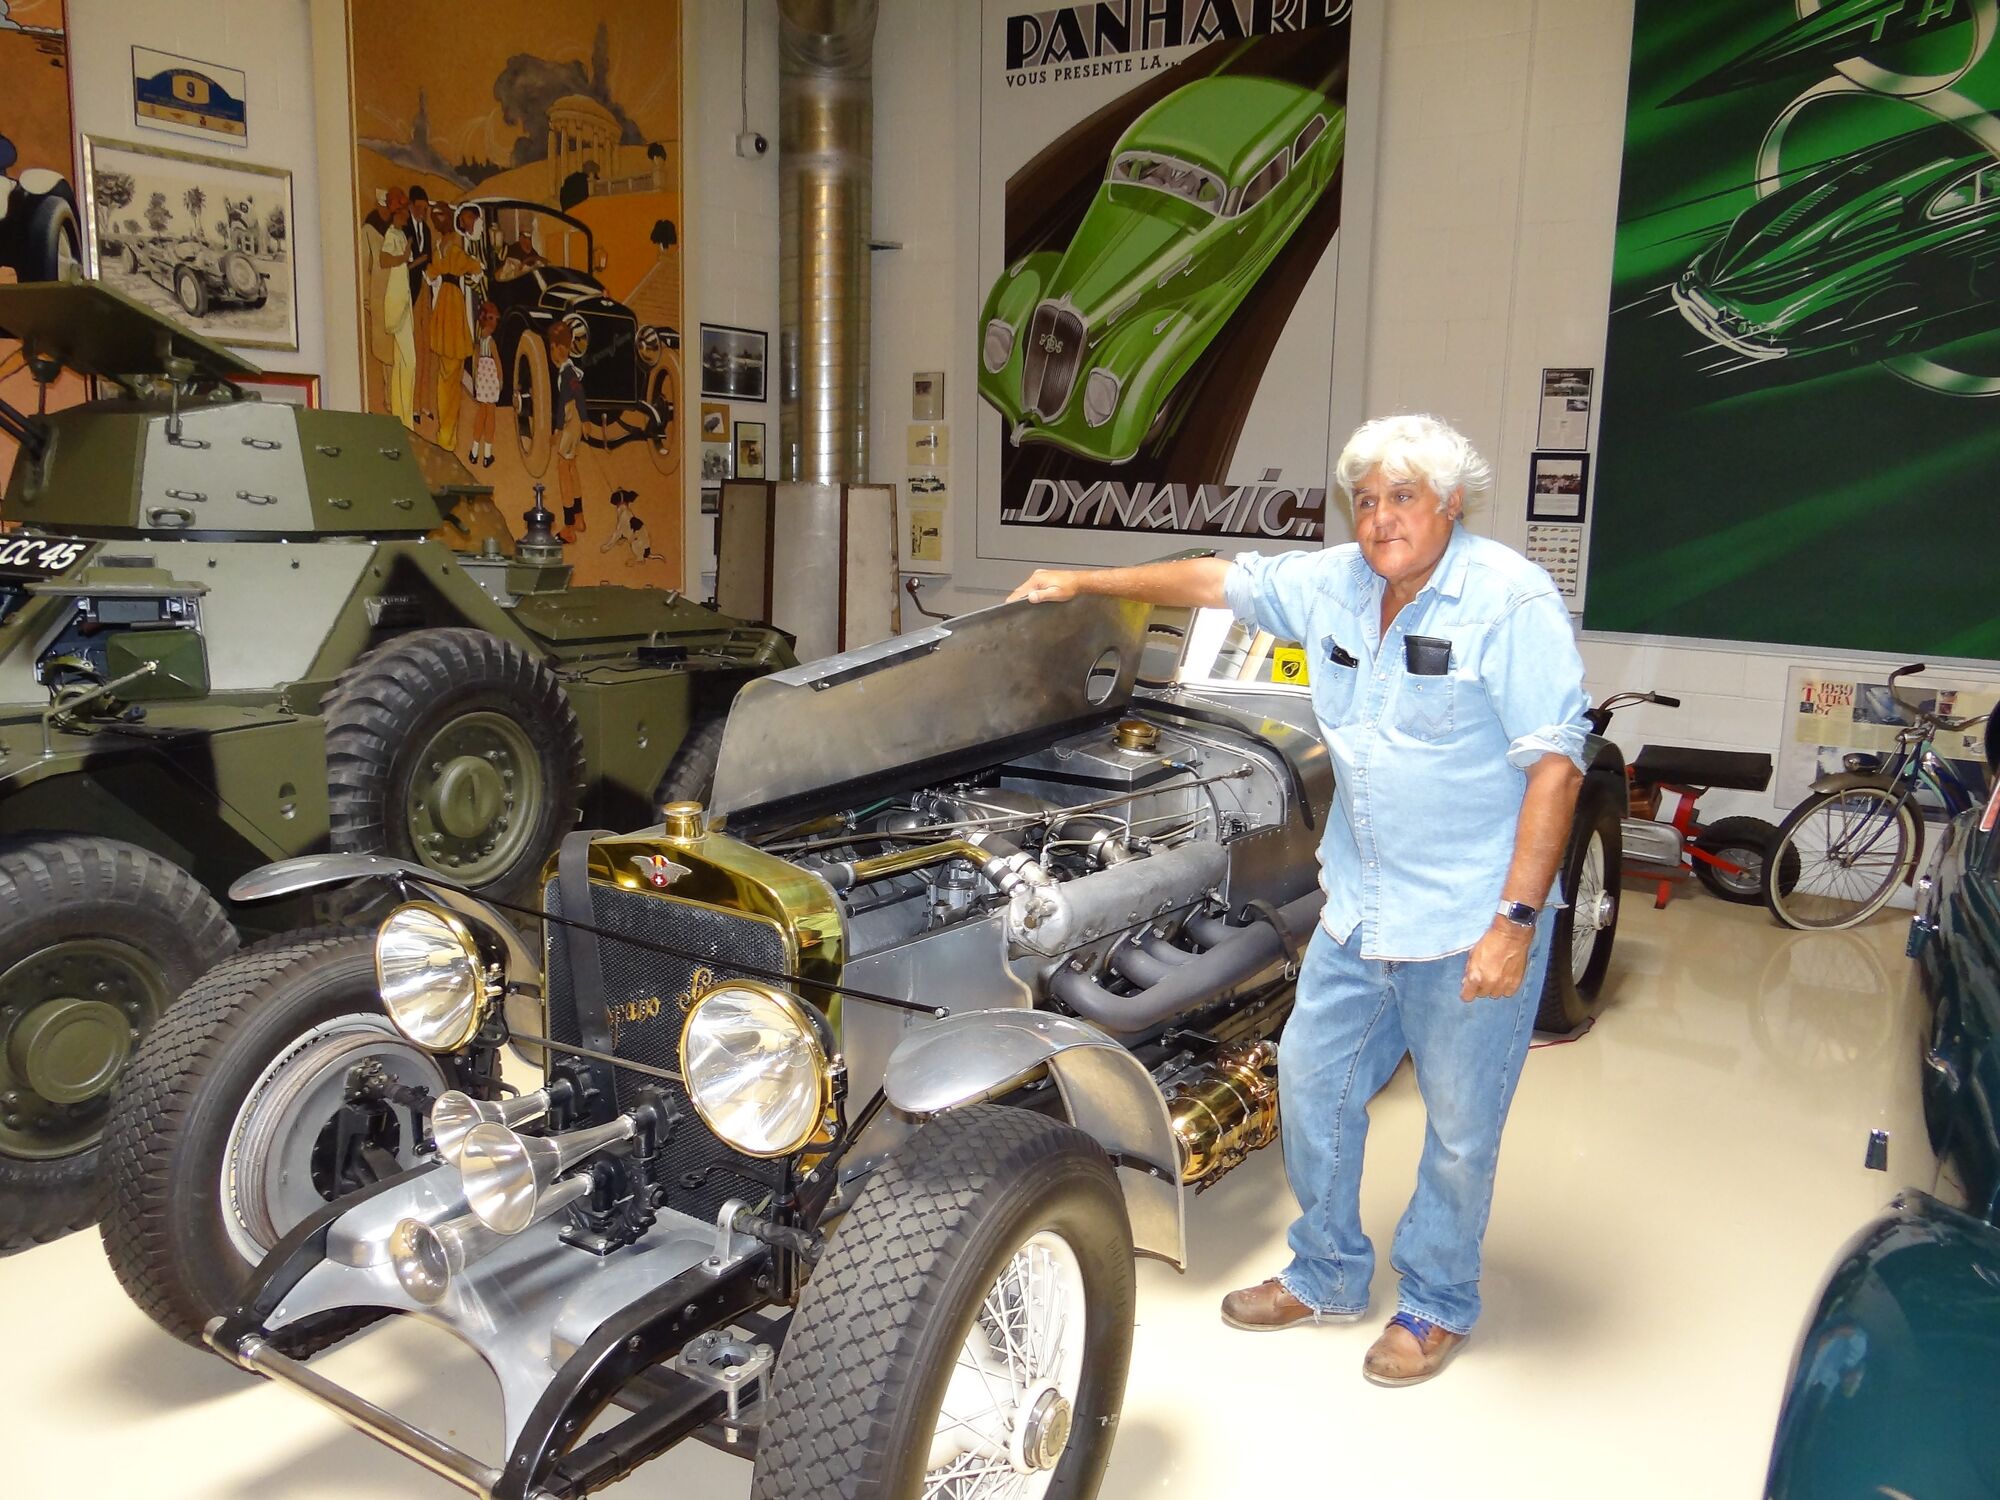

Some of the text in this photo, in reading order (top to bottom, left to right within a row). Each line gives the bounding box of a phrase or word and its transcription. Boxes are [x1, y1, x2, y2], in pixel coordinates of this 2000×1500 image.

[1006, 0, 1352, 71] PANHARD
[1006, 70, 1047, 88] VOUS
[1054, 58, 1133, 82] PRESENTE
[186, 81, 196, 98] 9
[38, 543, 87, 570] 45
[1820, 682, 1854, 697] 1939
